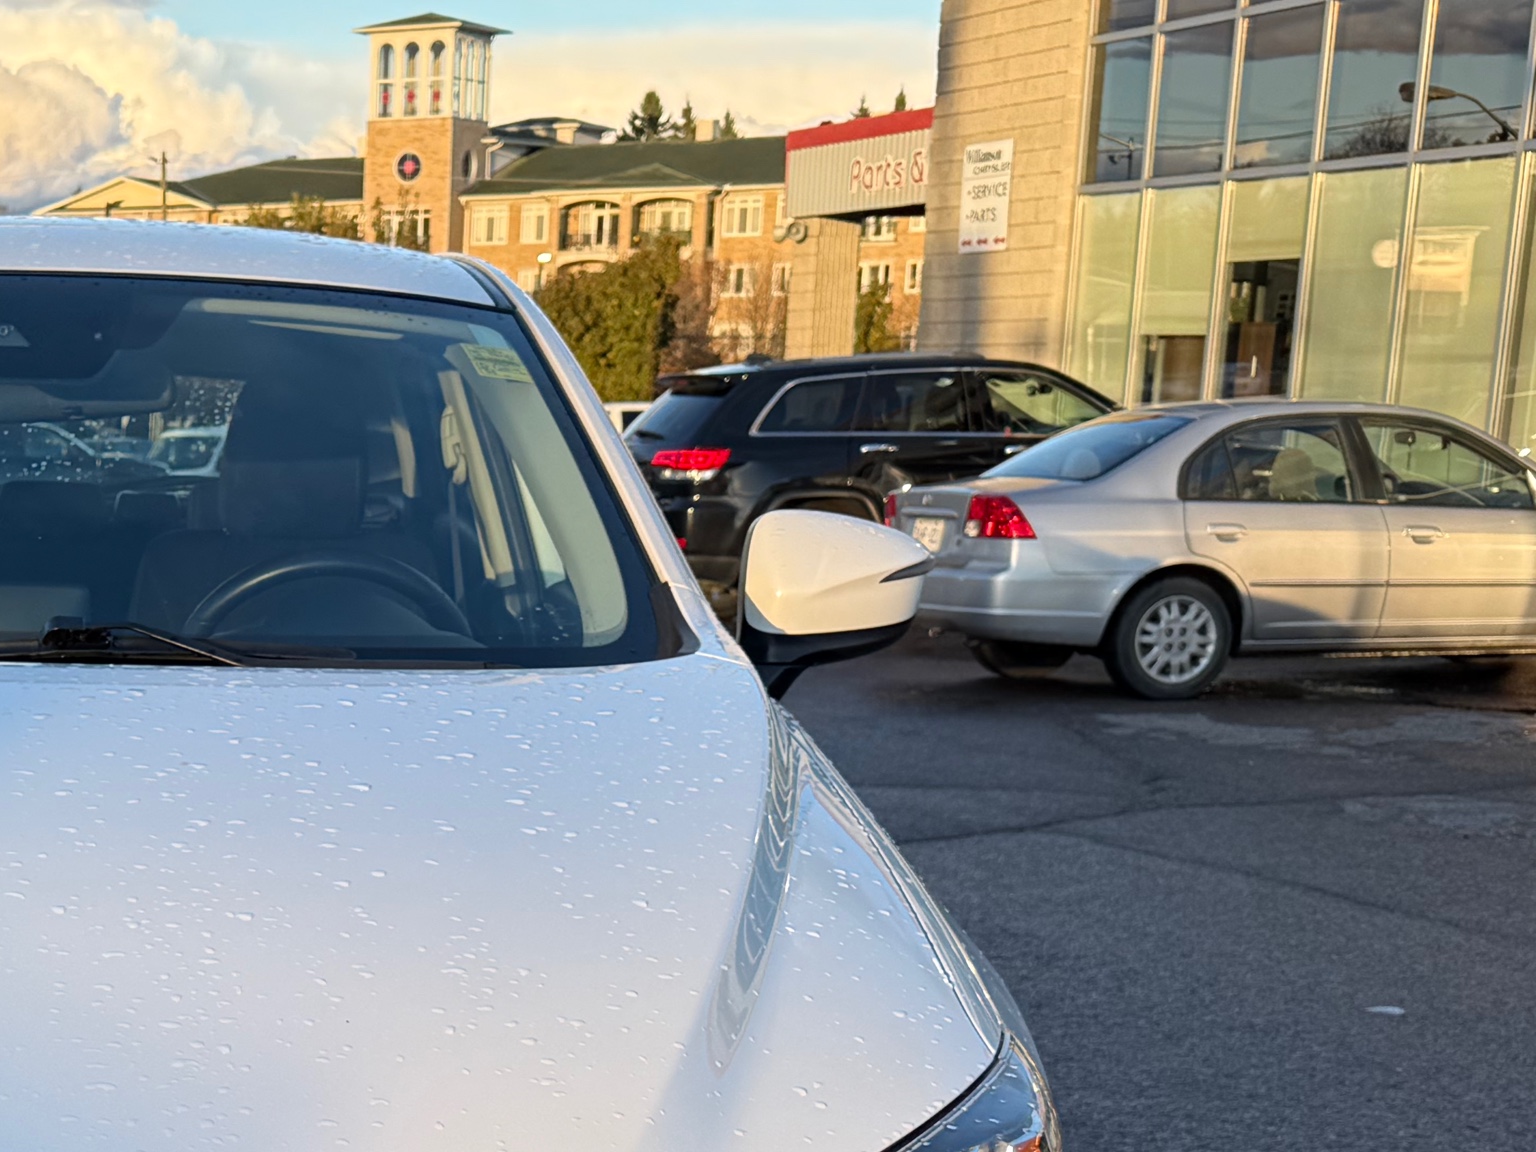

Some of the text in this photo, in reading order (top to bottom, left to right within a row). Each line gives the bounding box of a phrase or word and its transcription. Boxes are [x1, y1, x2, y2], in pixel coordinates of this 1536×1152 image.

[848, 149, 928, 193] Parts &
[972, 182, 1008, 200] SERVICE
[969, 207, 997, 222] PARTS
